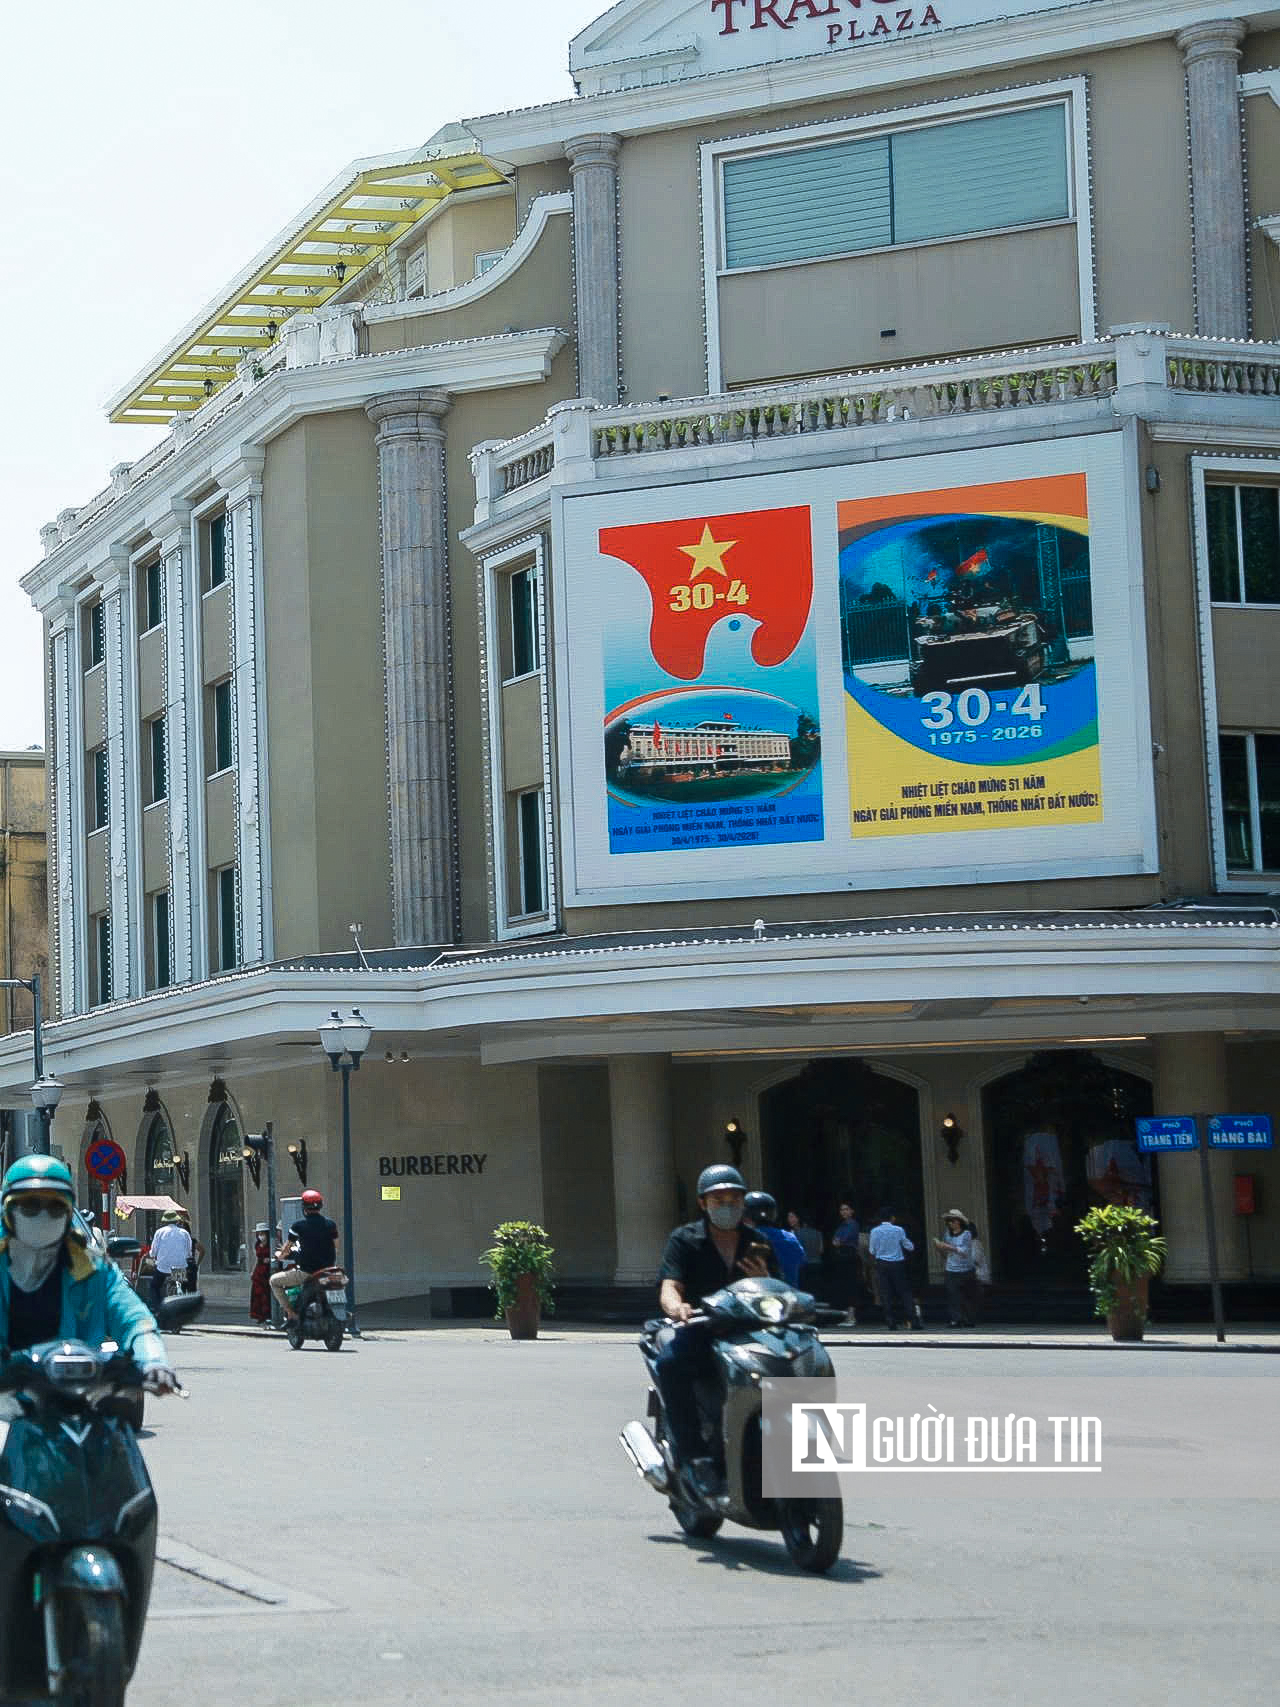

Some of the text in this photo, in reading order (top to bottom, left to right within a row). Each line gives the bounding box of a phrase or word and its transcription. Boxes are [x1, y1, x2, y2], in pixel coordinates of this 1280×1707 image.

[711, 0, 898, 35] TRA
[826, 4, 941, 45] PLAZA
[669, 579, 750, 613] 30-4
[920, 683, 1047, 729] 30-4
[901, 774, 1046, 800] NHIỆT LIỆT CHÀO MỪNG 51 NĂM
[853, 806, 878, 823] NGÀY
[880, 802, 899, 820] GIẢI
[901, 804, 932, 820] PHÓNG
[987, 795, 1018, 813] THỐNG
[1021, 793, 1046, 811] NHẤT
[379, 1153, 487, 1176] BURBERRY
